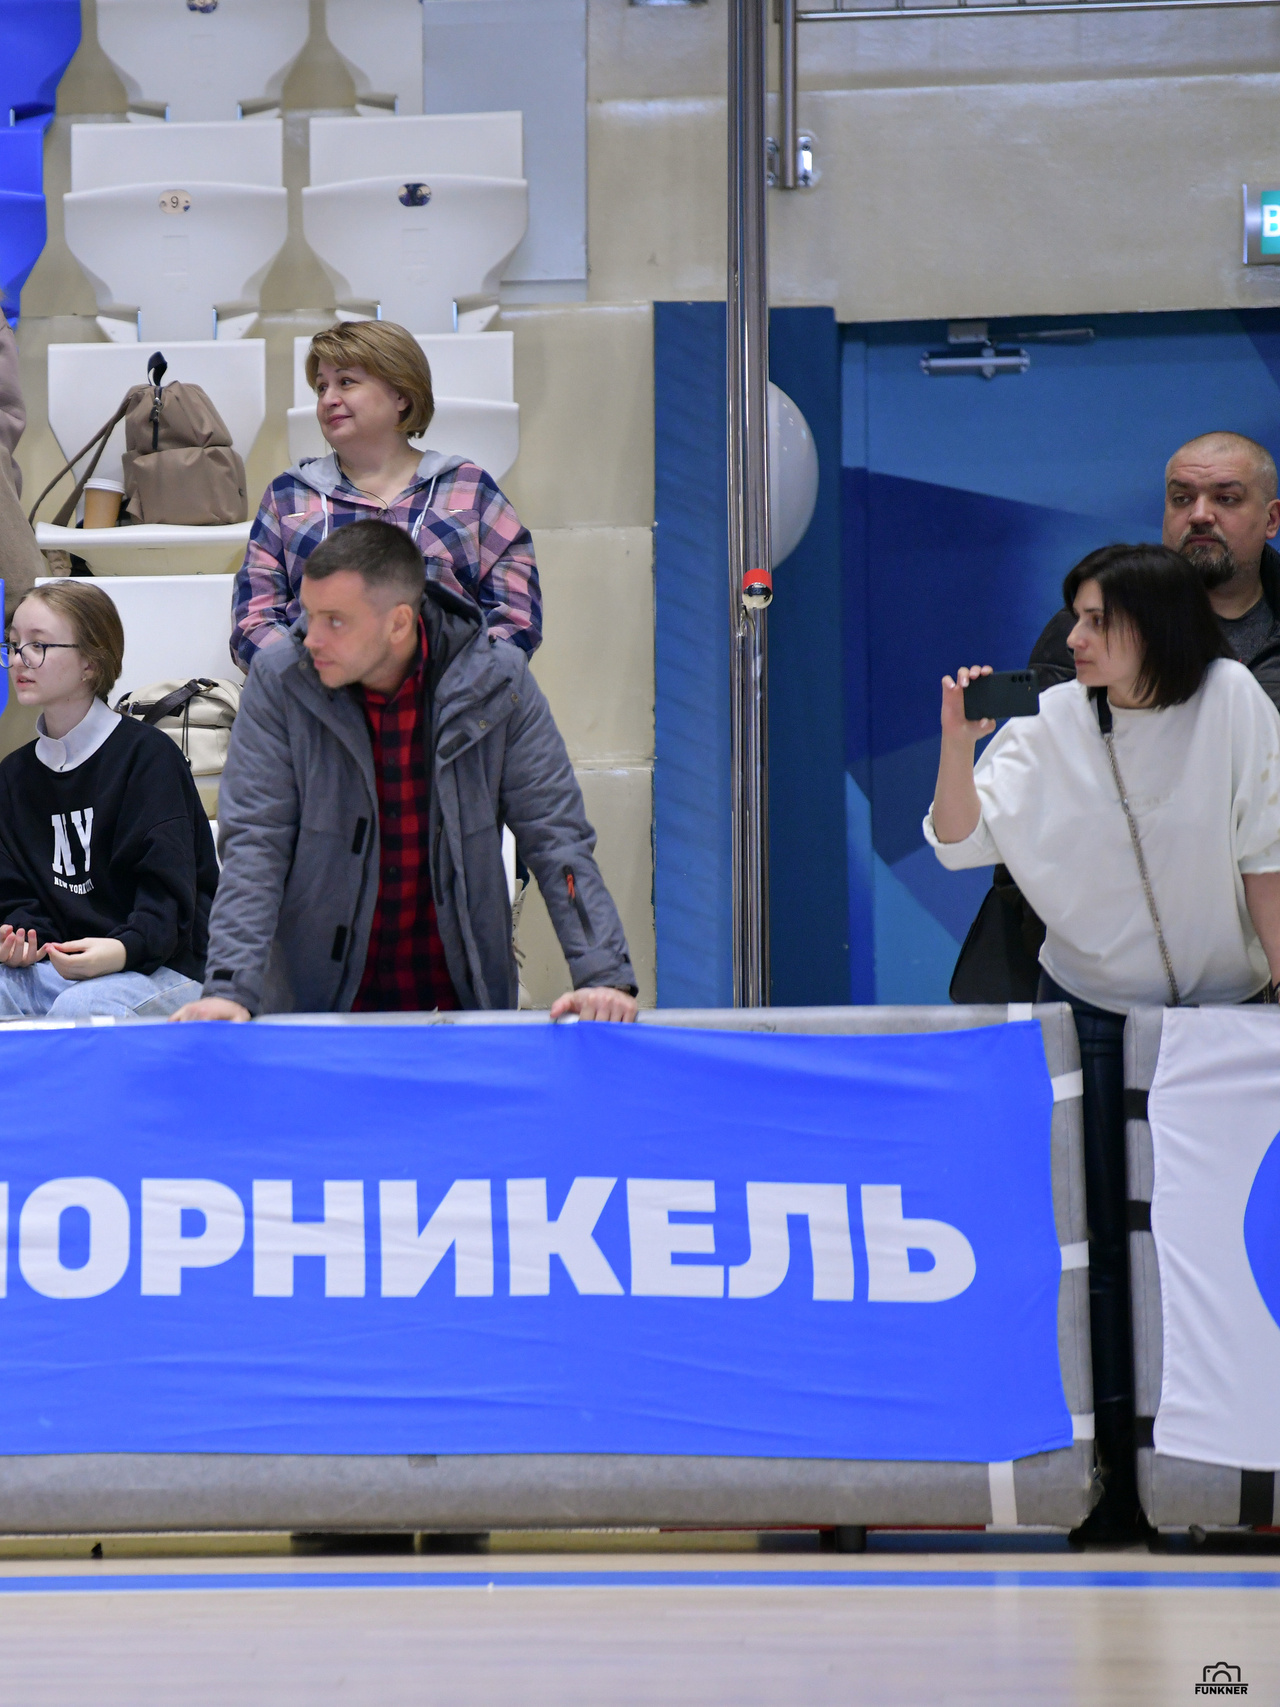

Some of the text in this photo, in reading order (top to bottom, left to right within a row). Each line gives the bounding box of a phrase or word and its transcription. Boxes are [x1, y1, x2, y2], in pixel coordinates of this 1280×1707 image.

[171, 196, 179, 208] 9
[52, 807, 93, 876] NY
[54, 876, 68, 889] NEW
